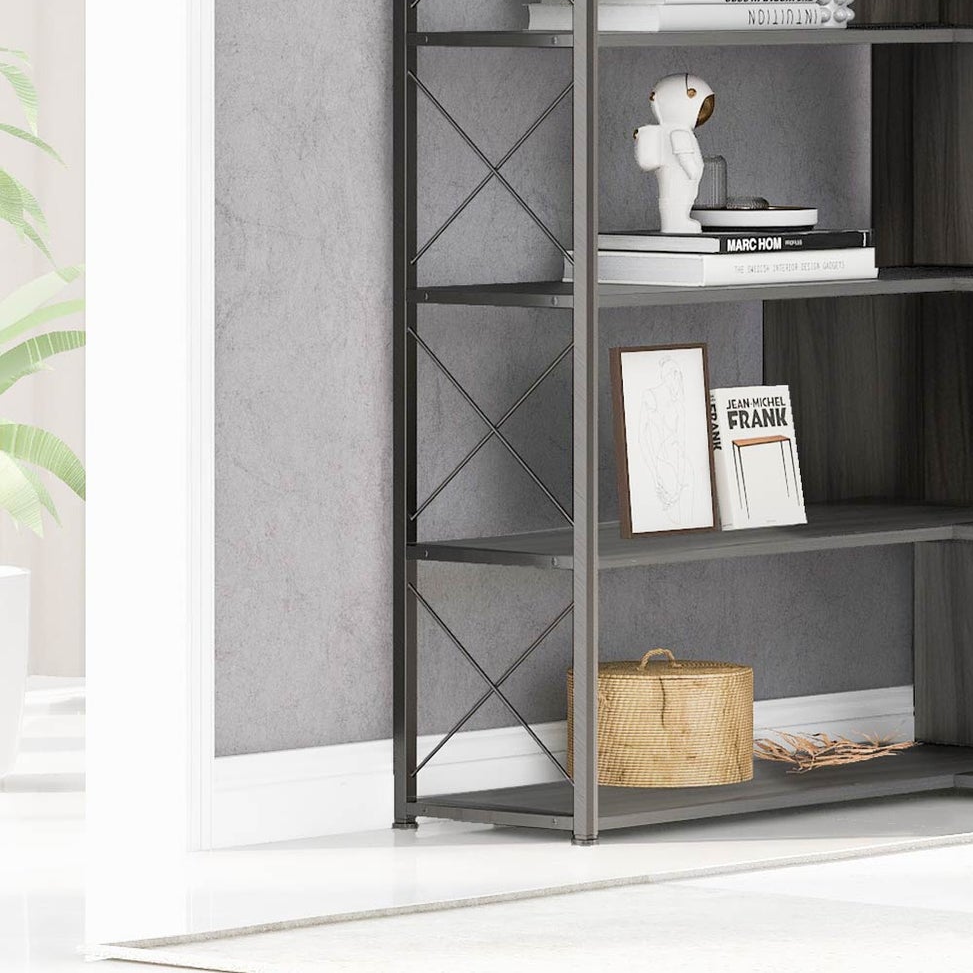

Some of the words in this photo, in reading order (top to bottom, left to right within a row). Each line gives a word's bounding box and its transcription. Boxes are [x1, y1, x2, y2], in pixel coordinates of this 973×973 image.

[747, 9, 818, 26] INTUITION
[727, 238, 757, 252] MARC
[758, 237, 782, 250] HOM
[734, 265, 745, 274] THE
[726, 396, 786, 410] JEAN-MICHEL
[727, 407, 788, 430] FRANK
